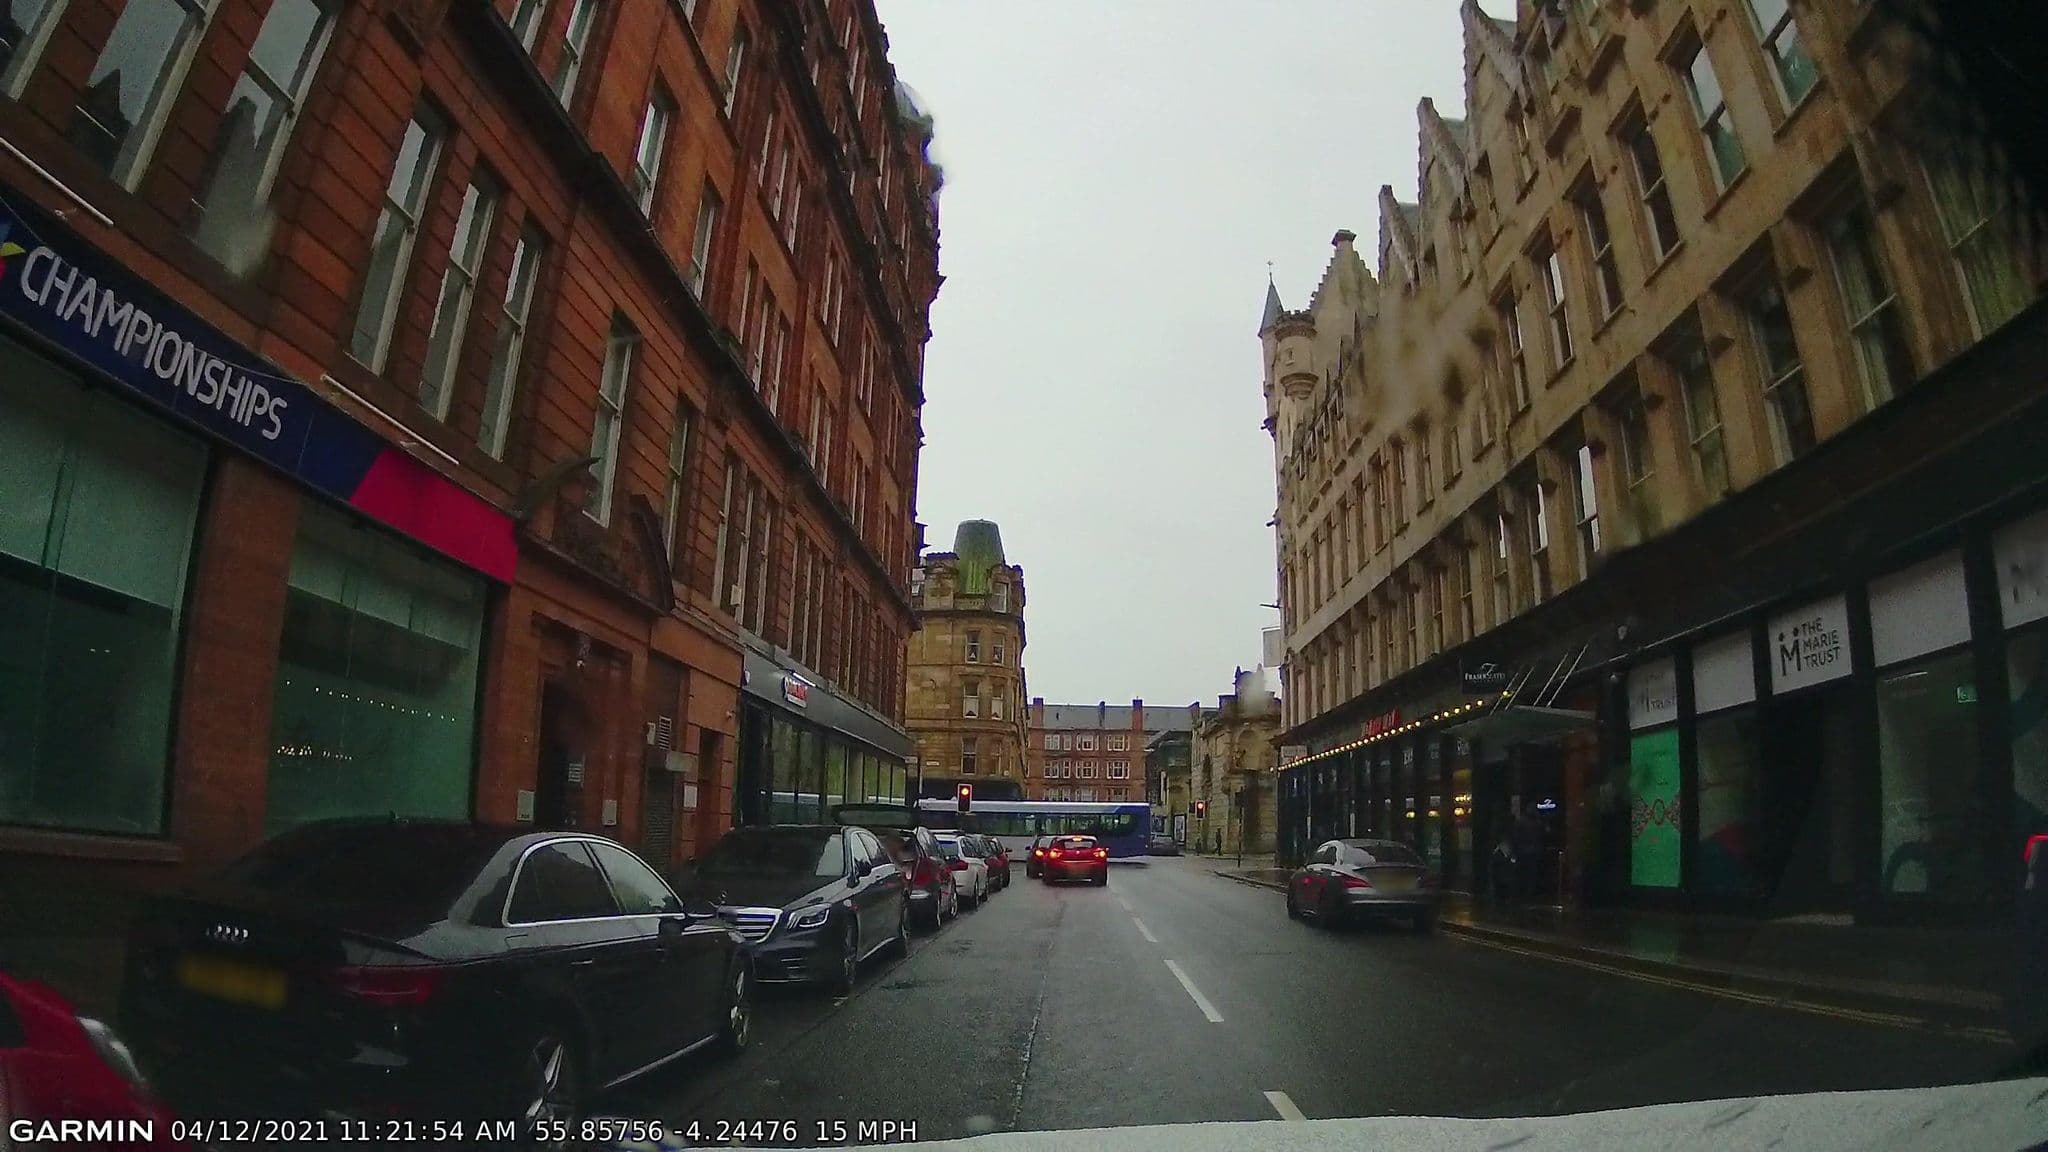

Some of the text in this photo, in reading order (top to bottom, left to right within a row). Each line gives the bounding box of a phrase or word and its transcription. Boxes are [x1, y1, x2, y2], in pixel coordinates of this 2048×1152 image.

[20, 246, 288, 441] CHAMPIONSHIPS
[1802, 617, 1823, 634] THE
[1804, 630, 1839, 653] MARIE
[1804, 646, 1841, 668] TRUST
